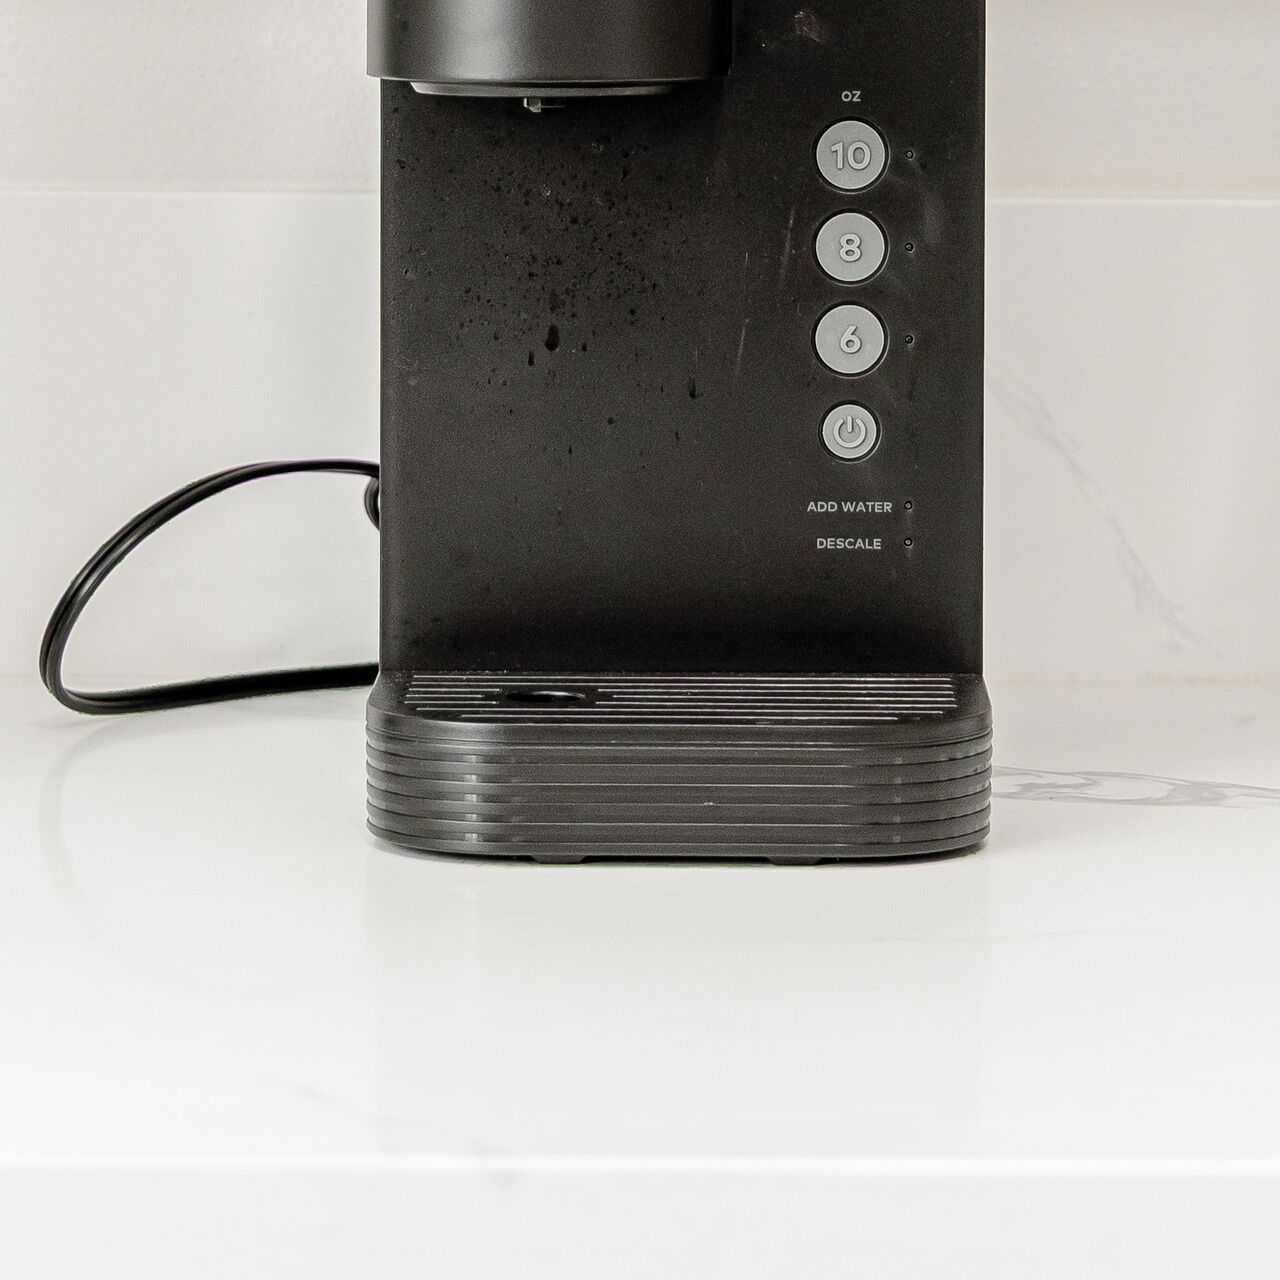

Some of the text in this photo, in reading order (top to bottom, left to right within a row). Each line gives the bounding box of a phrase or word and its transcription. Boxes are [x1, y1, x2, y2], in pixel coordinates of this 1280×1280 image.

[841, 90, 862, 102] OZ
[830, 141, 871, 170] 10
[839, 232, 862, 262] 8
[839, 325, 862, 354] 6
[806, 501, 893, 513] ADD WATER
[816, 538, 882, 549] DESCALE
